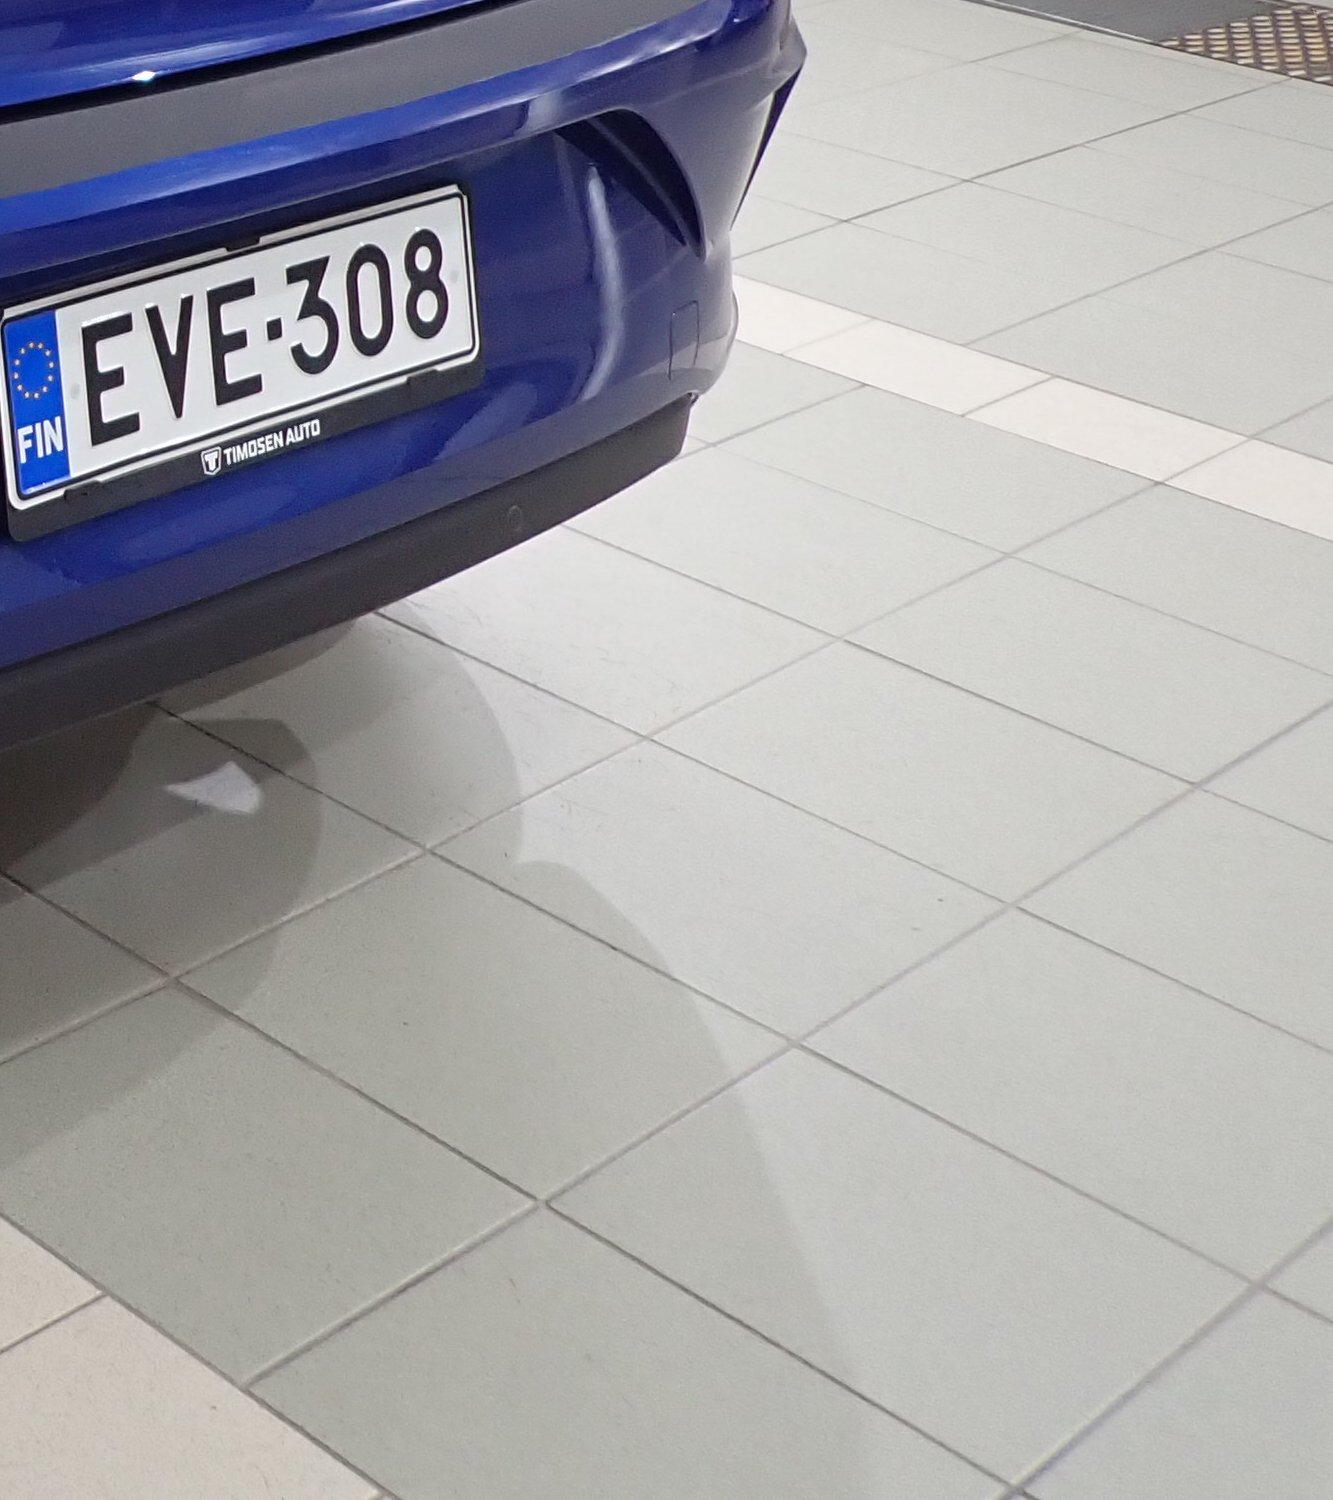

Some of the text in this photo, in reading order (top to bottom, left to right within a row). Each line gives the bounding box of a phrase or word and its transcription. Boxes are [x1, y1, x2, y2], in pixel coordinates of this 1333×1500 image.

[81, 228, 449, 447] EVE-308
[17, 415, 64, 464] FIN
[223, 431, 284, 466] TIMOSEN
[285, 418, 321, 446] AUTO
